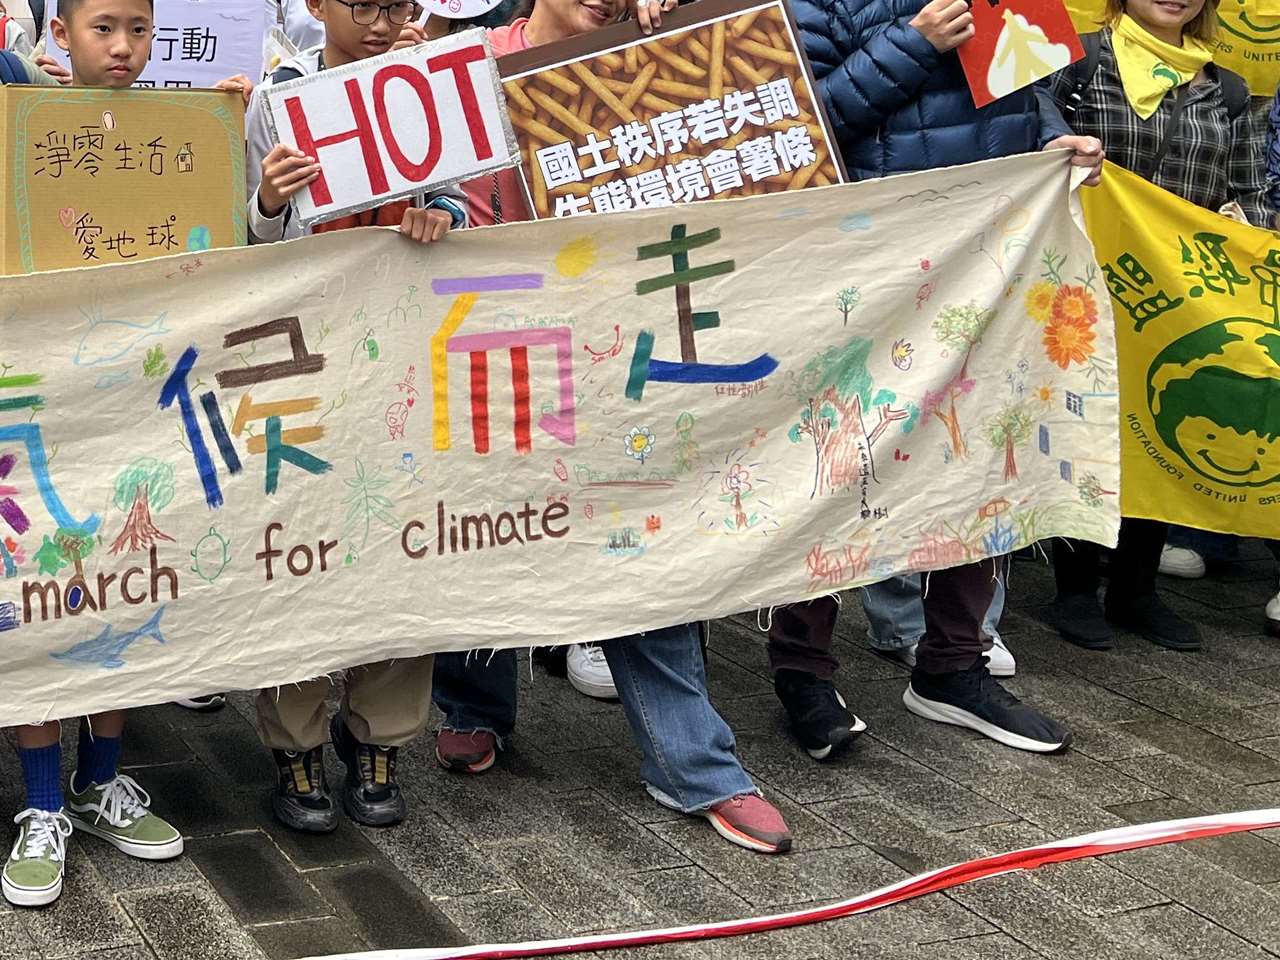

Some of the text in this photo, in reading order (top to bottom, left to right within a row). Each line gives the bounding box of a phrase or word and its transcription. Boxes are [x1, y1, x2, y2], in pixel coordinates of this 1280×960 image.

[1243, 48, 1280, 63] UNITE
[33, 125, 167, 178] 淨零生活
[284, 44, 495, 208] HOT
[535, 77, 800, 191] 國土秩序若失調
[71, 212, 180, 261] 愛地球
[22, 498, 570, 624] march for climate
